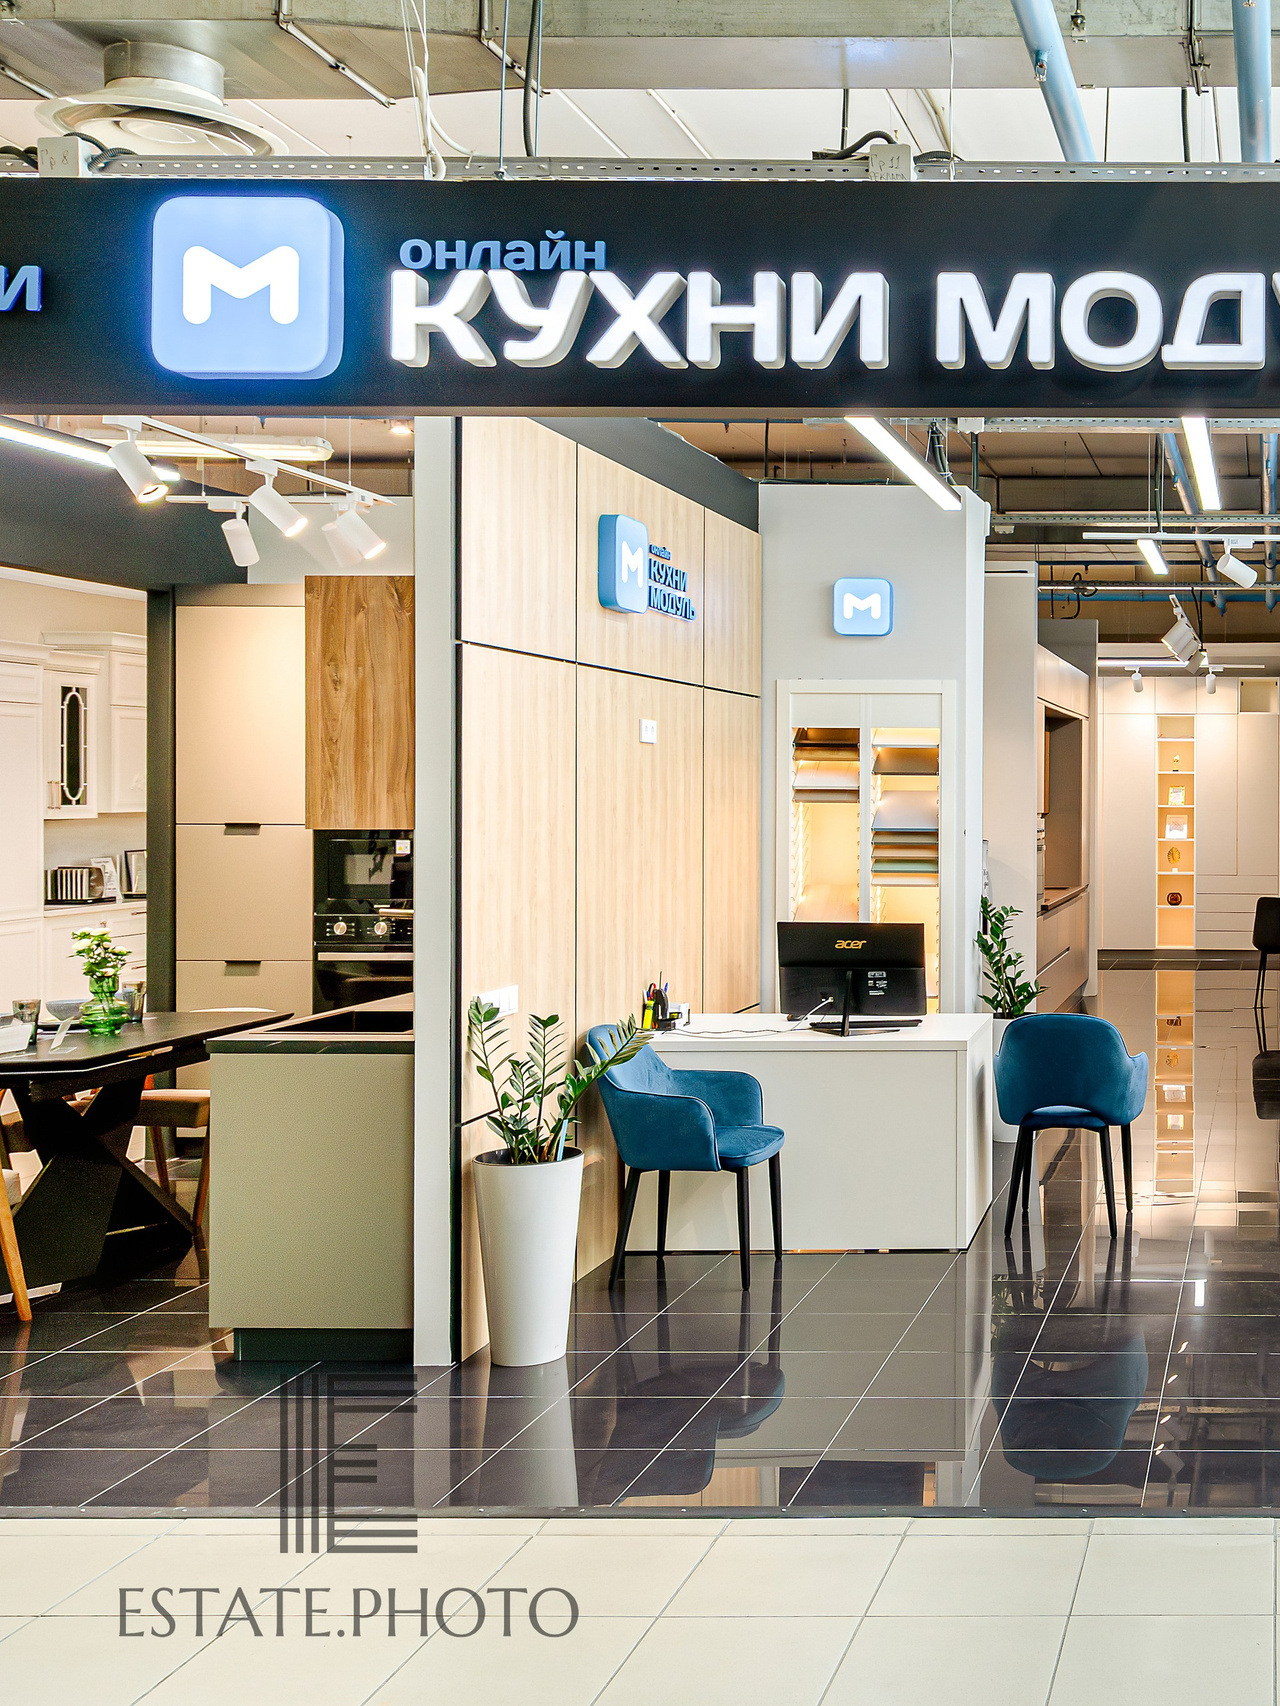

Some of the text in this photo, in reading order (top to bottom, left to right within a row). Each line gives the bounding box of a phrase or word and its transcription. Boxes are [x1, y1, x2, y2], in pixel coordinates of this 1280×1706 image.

[399, 229, 606, 271] онлайн
[389, 269, 889, 370] КУХНИ
[648, 558, 688, 593] КУХНИ
[648, 585, 697, 621] МОДУЛЬ
[835, 940, 867, 949] acer
